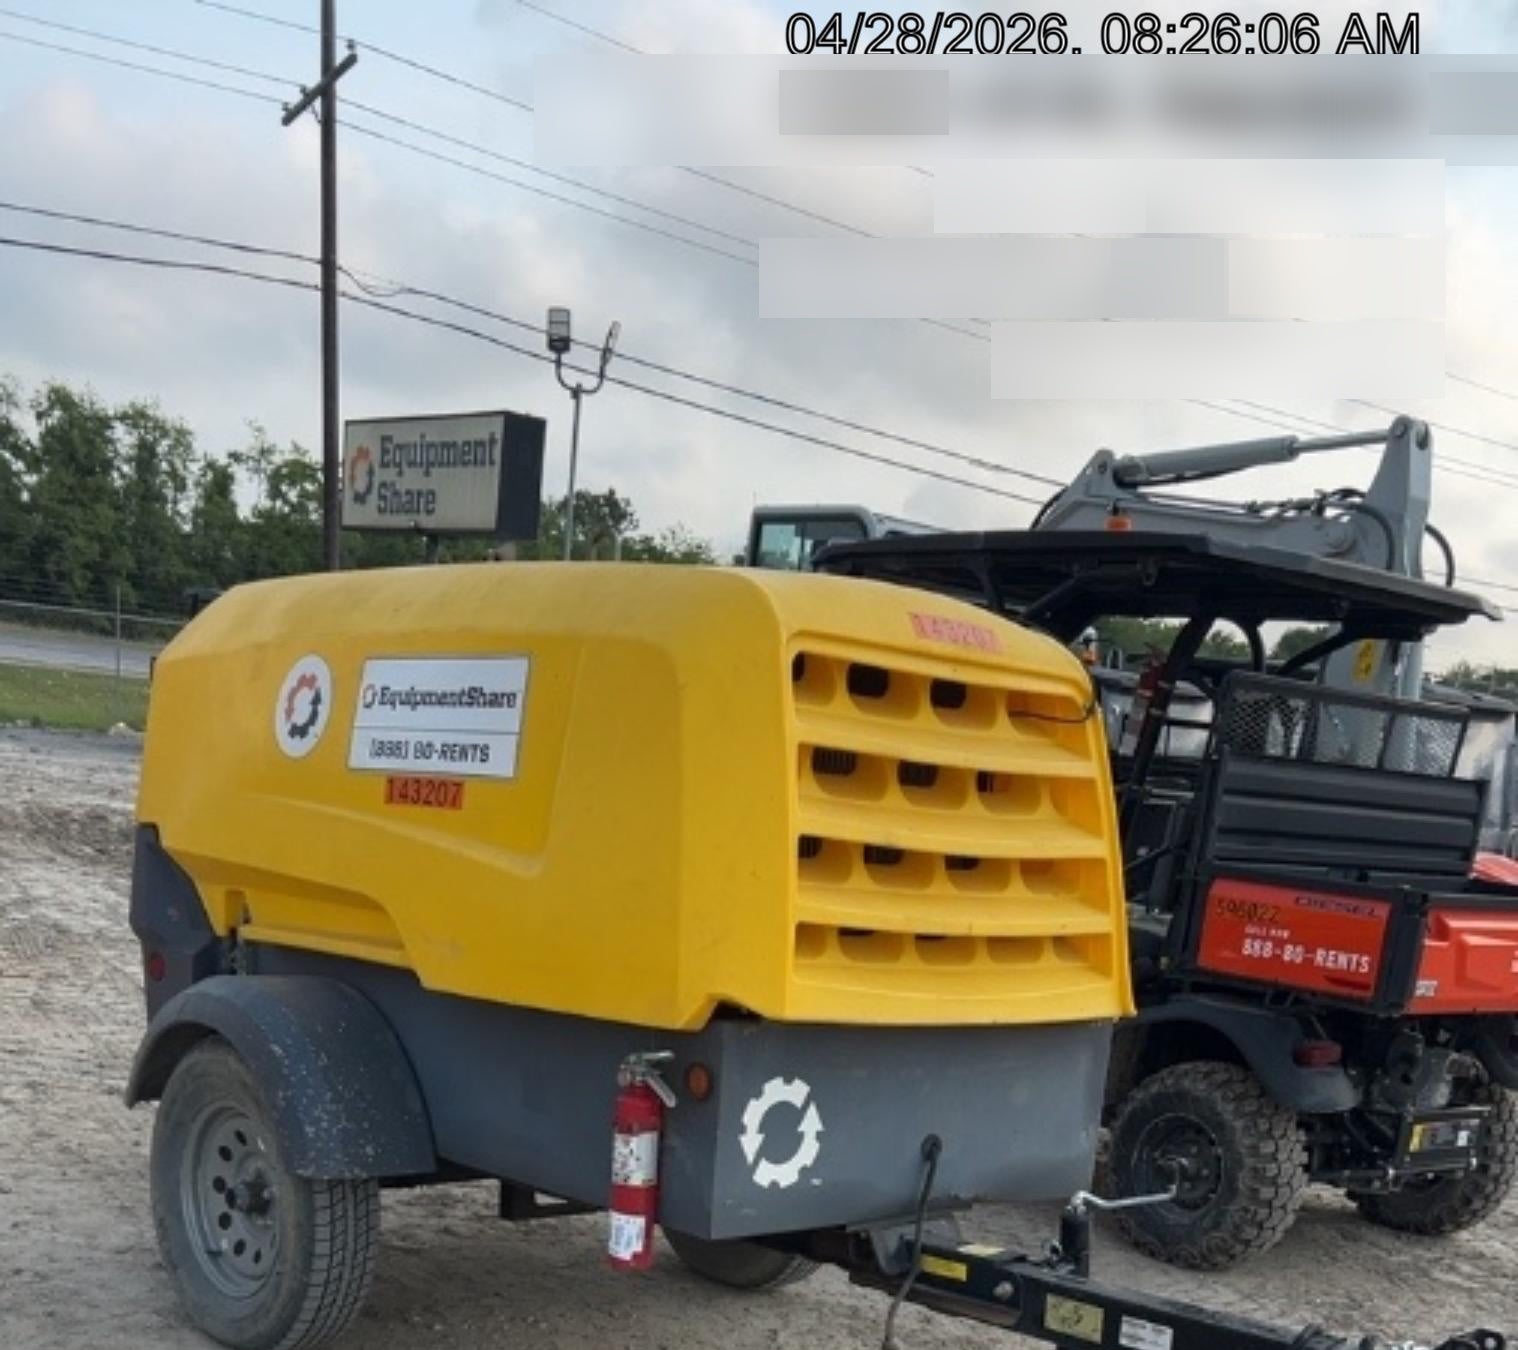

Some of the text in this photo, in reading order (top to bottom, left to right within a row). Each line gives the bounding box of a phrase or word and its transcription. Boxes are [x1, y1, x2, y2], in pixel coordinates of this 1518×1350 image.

[379, 432, 498, 477] Equipment
[377, 480, 436, 515] Share
[378, 686, 517, 711] EquipmentShare
[384, 775, 465, 809] 143207
[1241, 938, 1372, 973] 888-80-RENTS
